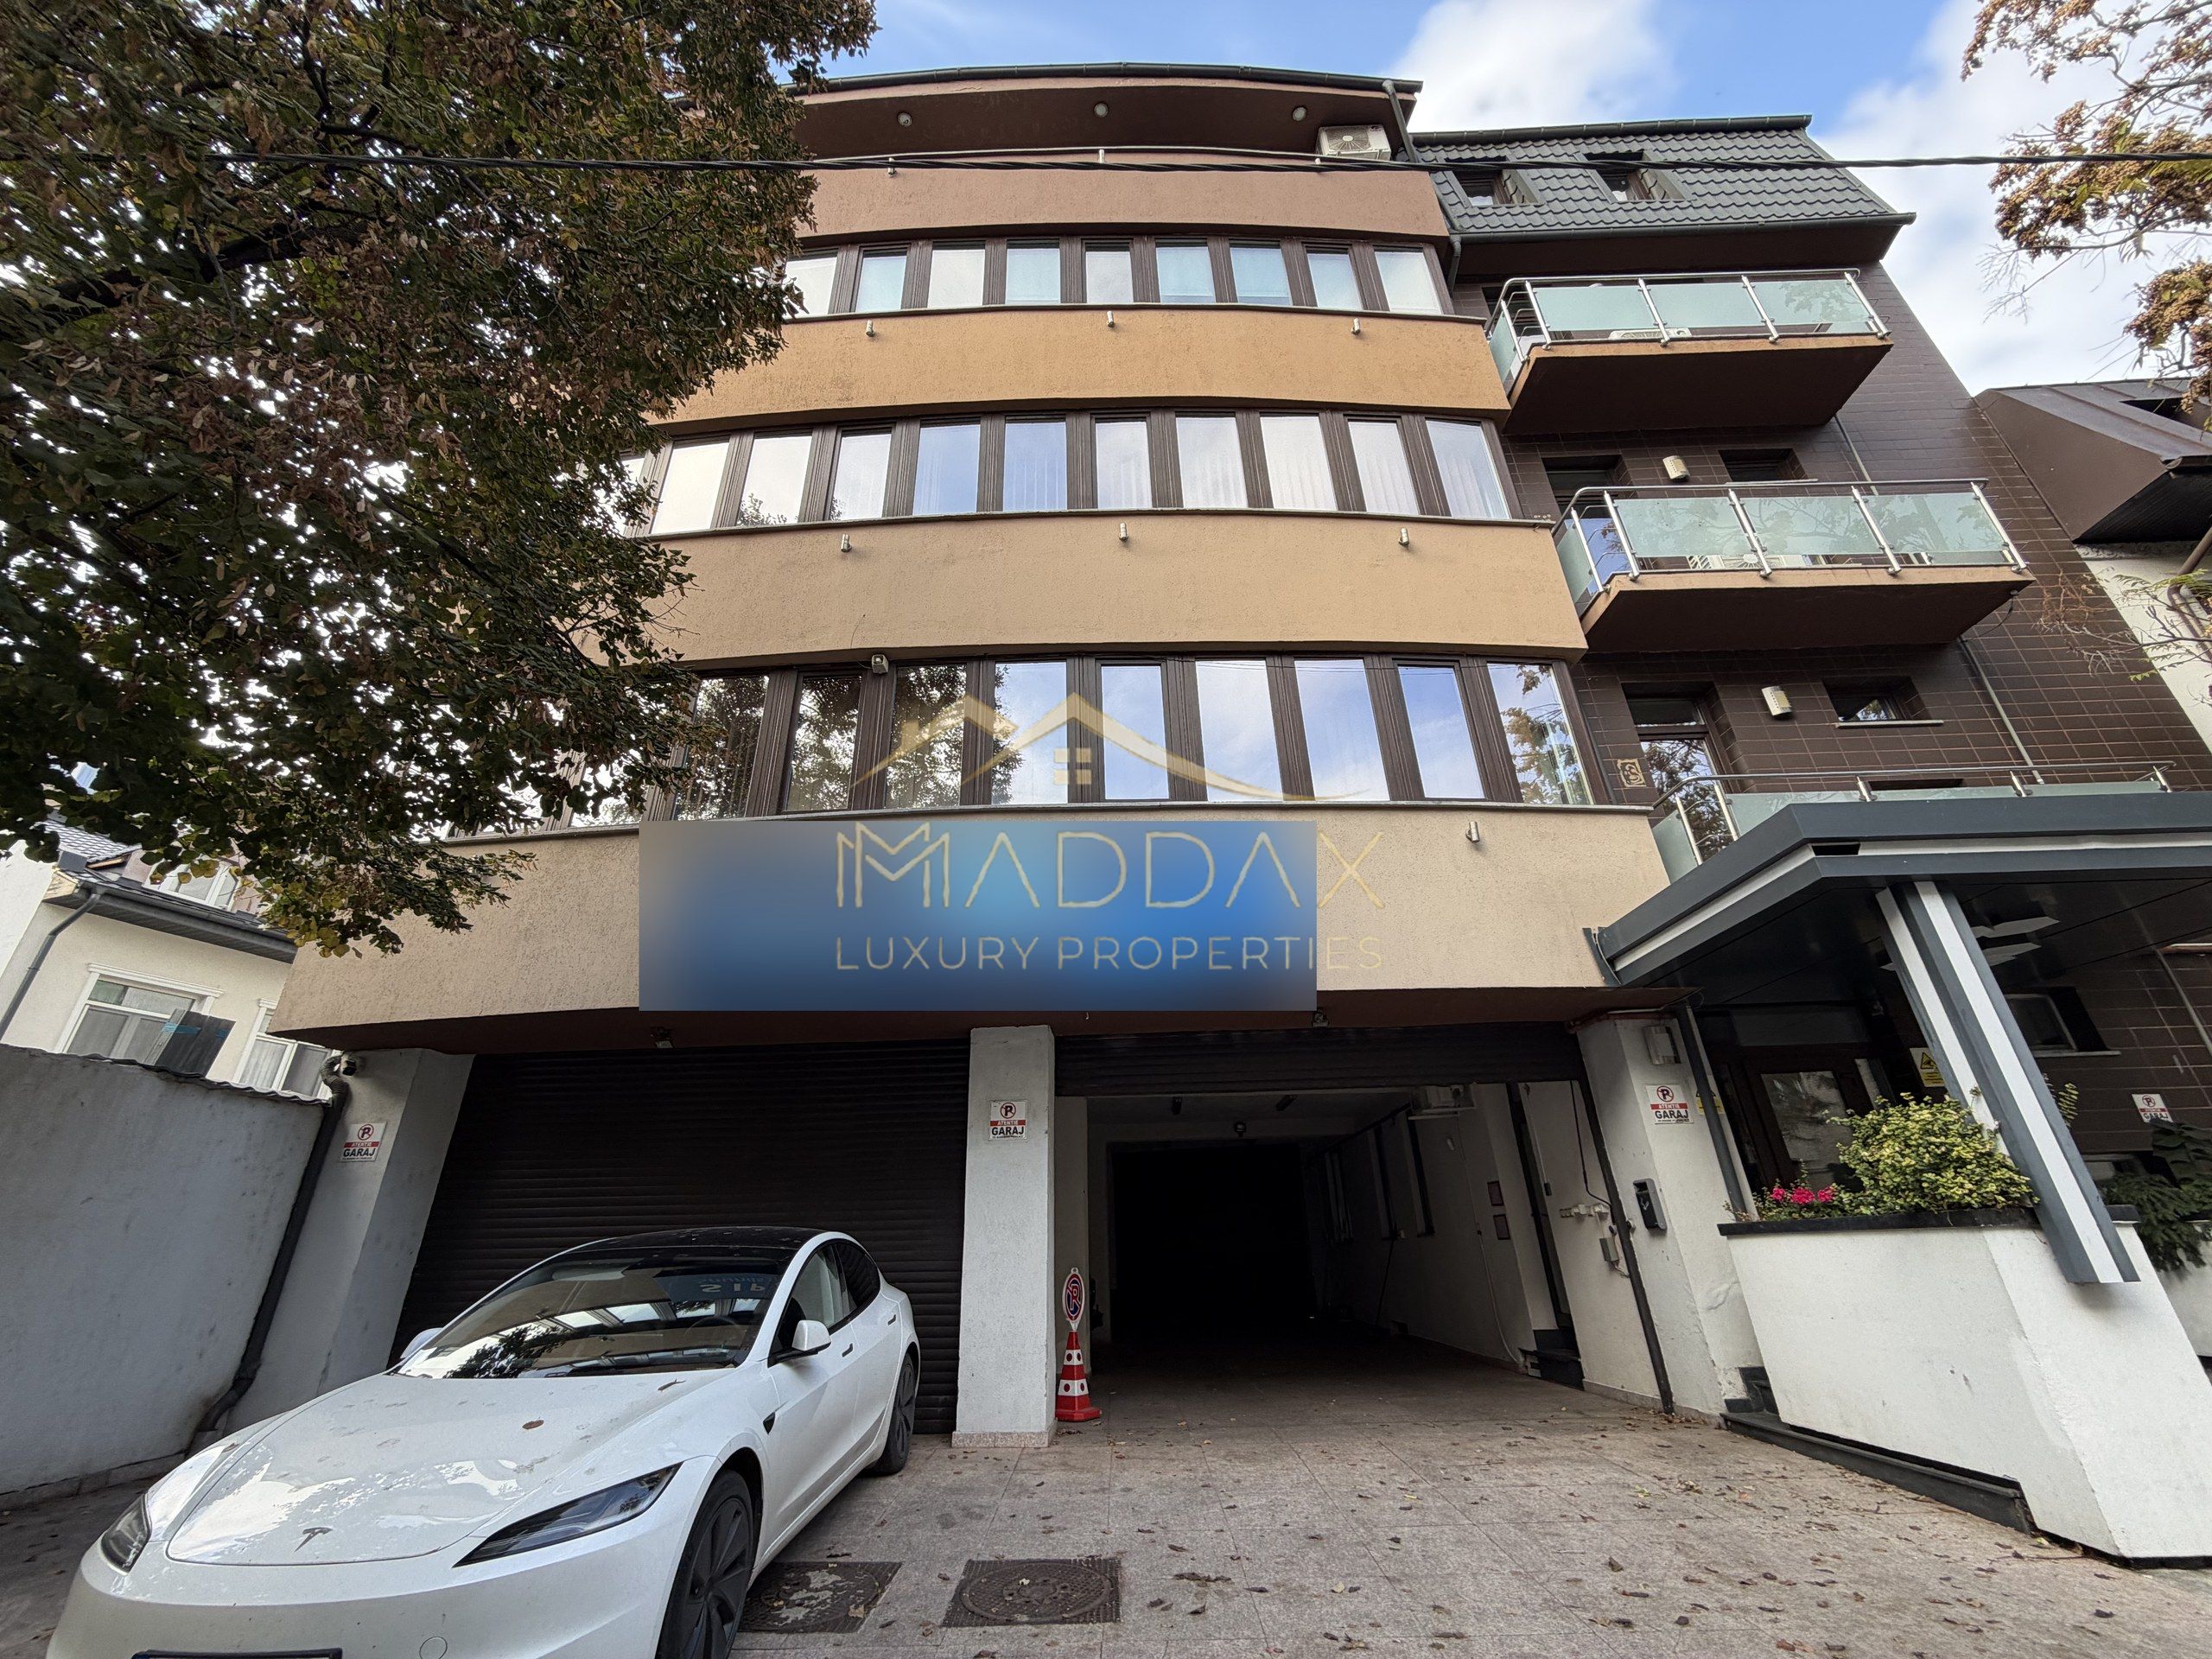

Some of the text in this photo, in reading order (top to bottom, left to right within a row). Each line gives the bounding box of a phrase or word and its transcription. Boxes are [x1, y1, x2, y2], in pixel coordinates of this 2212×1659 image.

[1655, 1109, 1689, 1119] GARAJ
[991, 1127, 1024, 1135] GARAJ
[343, 1148, 375, 1157] GARAJ
